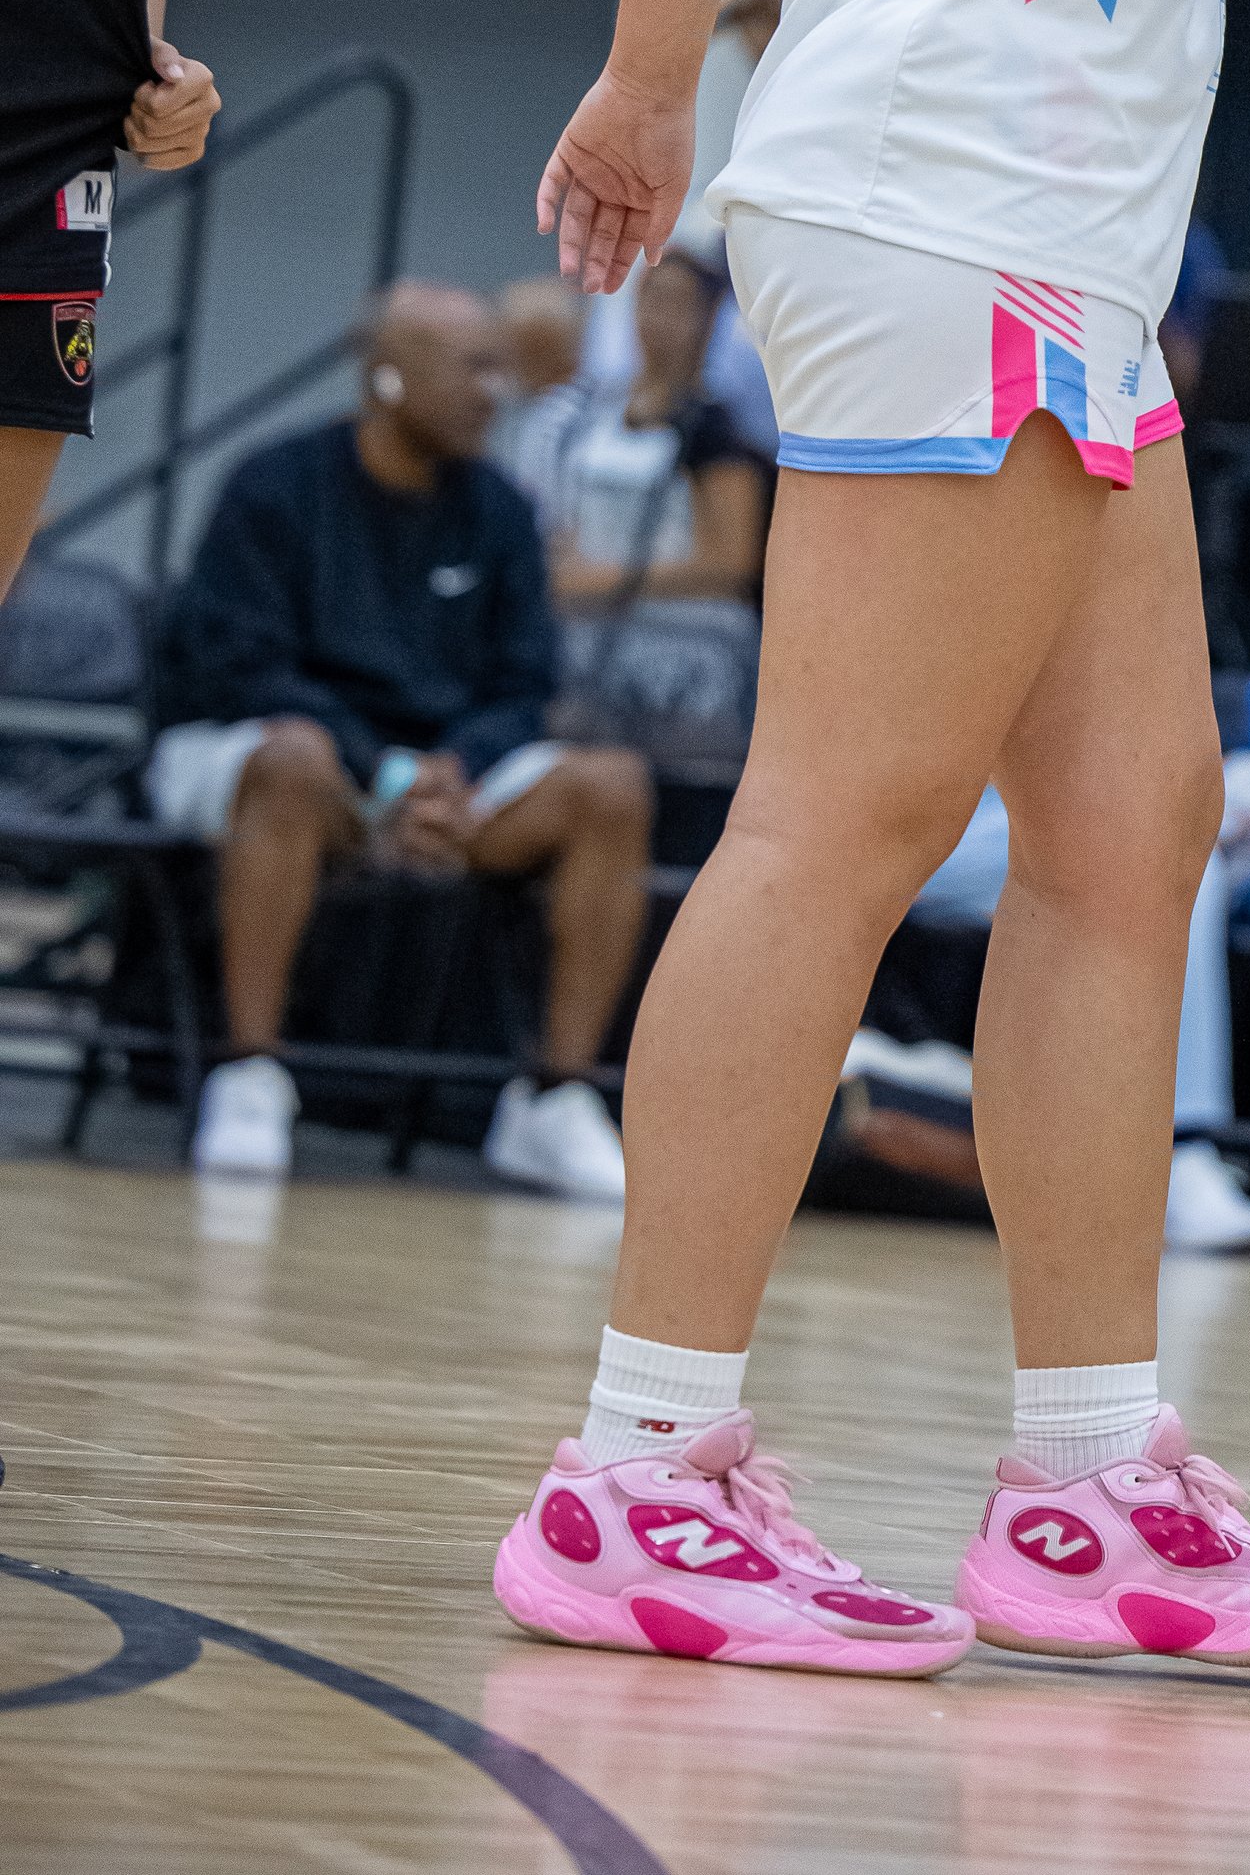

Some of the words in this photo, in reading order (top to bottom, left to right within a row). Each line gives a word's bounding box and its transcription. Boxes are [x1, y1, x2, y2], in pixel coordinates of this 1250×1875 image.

[84, 180, 102, 215] M
[646, 1519, 744, 1569] N
[1018, 1522, 1091, 1562] N
